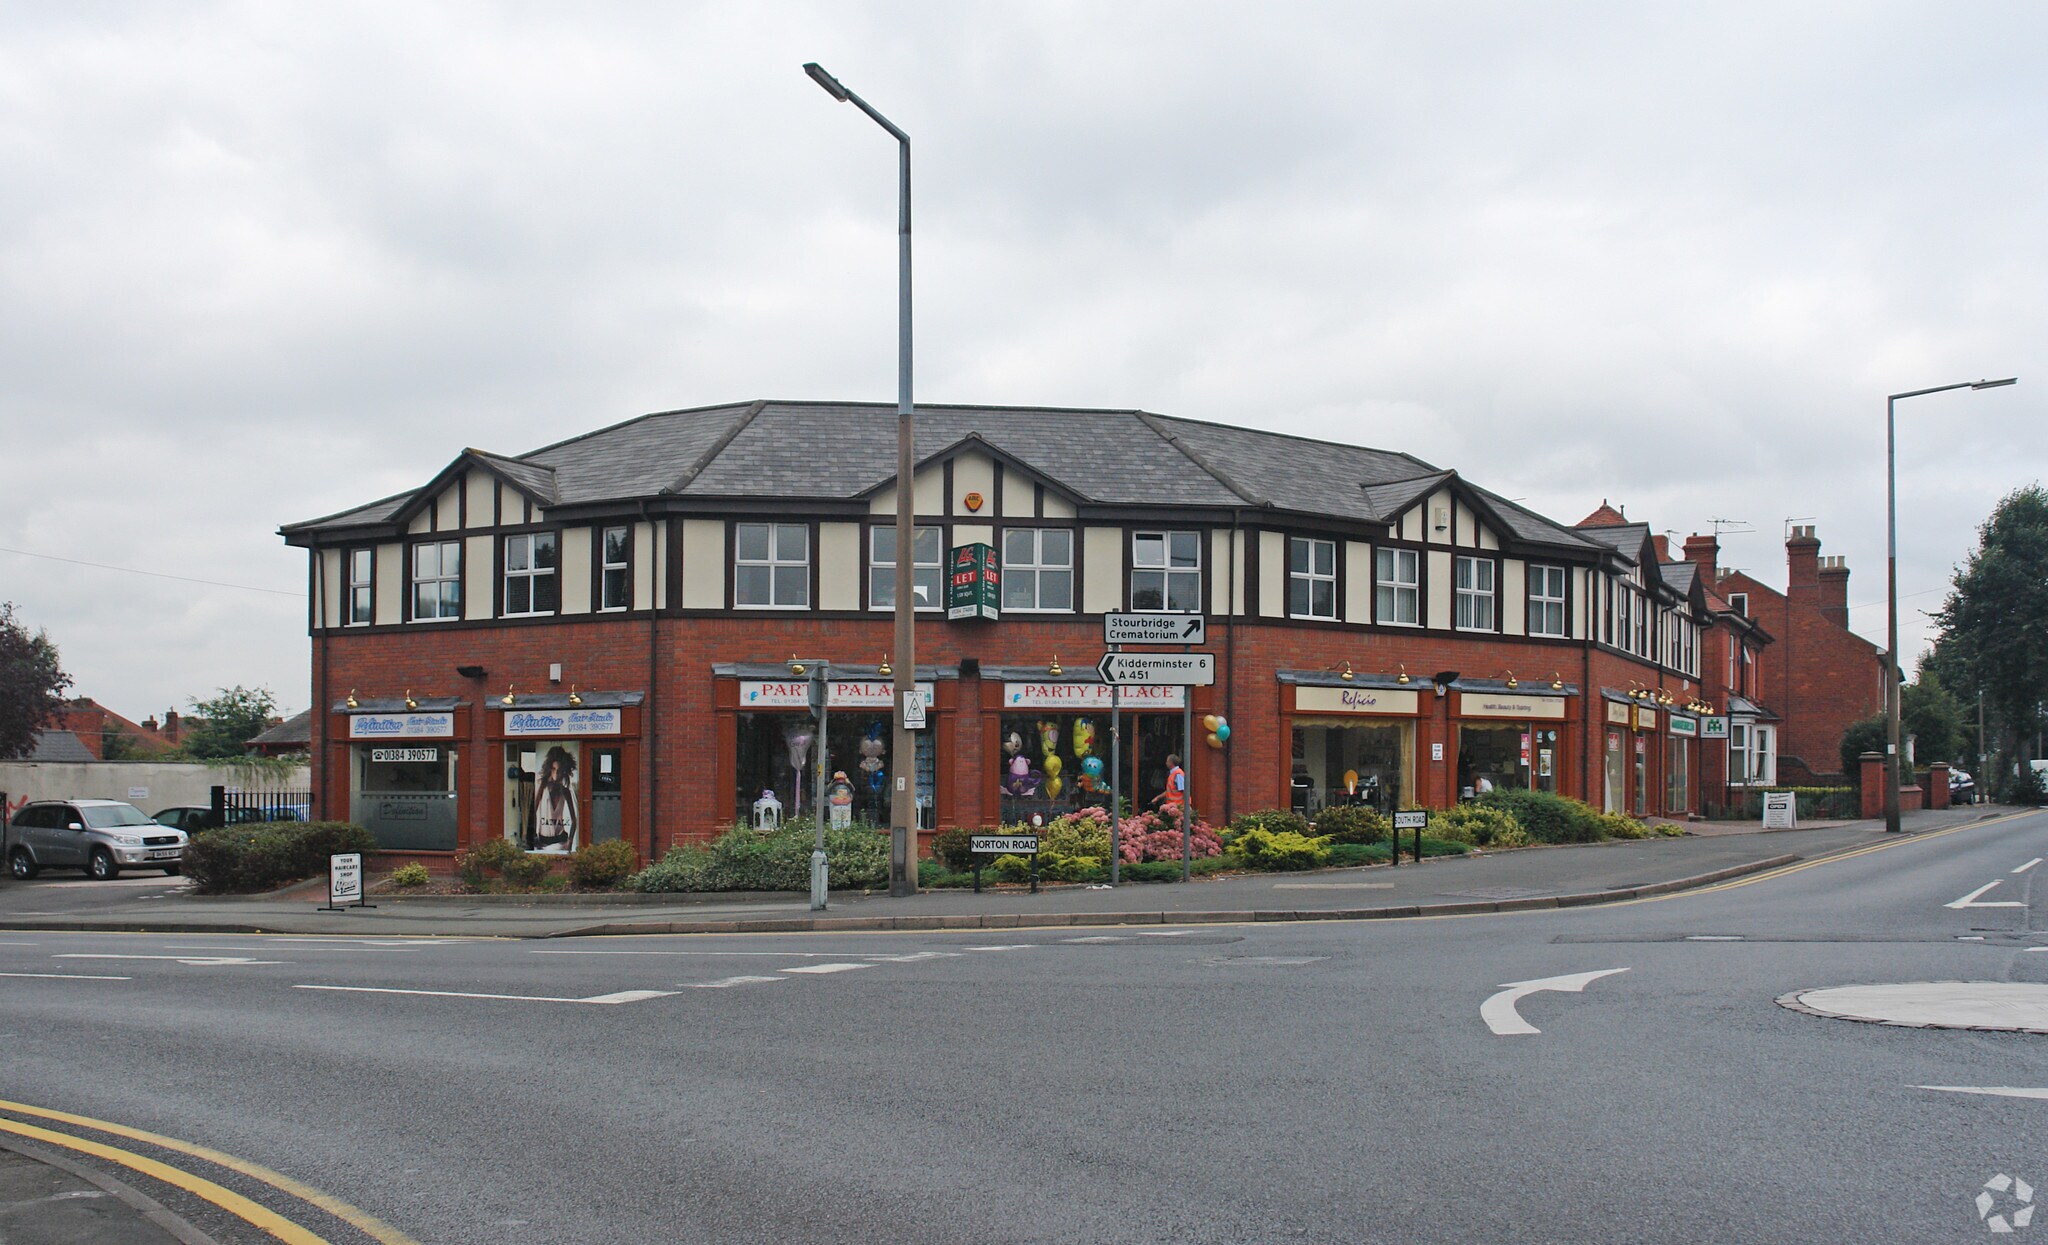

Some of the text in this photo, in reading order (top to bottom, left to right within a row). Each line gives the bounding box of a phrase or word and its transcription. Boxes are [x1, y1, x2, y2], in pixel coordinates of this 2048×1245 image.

[956, 572, 974, 584] LET
[986, 570, 996, 582] LET
[1112, 618, 1175, 630] Stourbridge
[1110, 630, 1178, 639] Crematorium
[1118, 659, 1206, 668] Kidderminster 6
[762, 684, 895, 696] PART PALA
[1024, 686, 1088, 698] PARTY
[355, 718, 404, 734] Definition
[510, 712, 614, 732] Definition Hair Studio
[384, 750, 436, 760] 01384 390577
[1394, 816, 1425, 824] SOUTH ROAD
[972, 840, 1037, 849] NORTON ROAD
